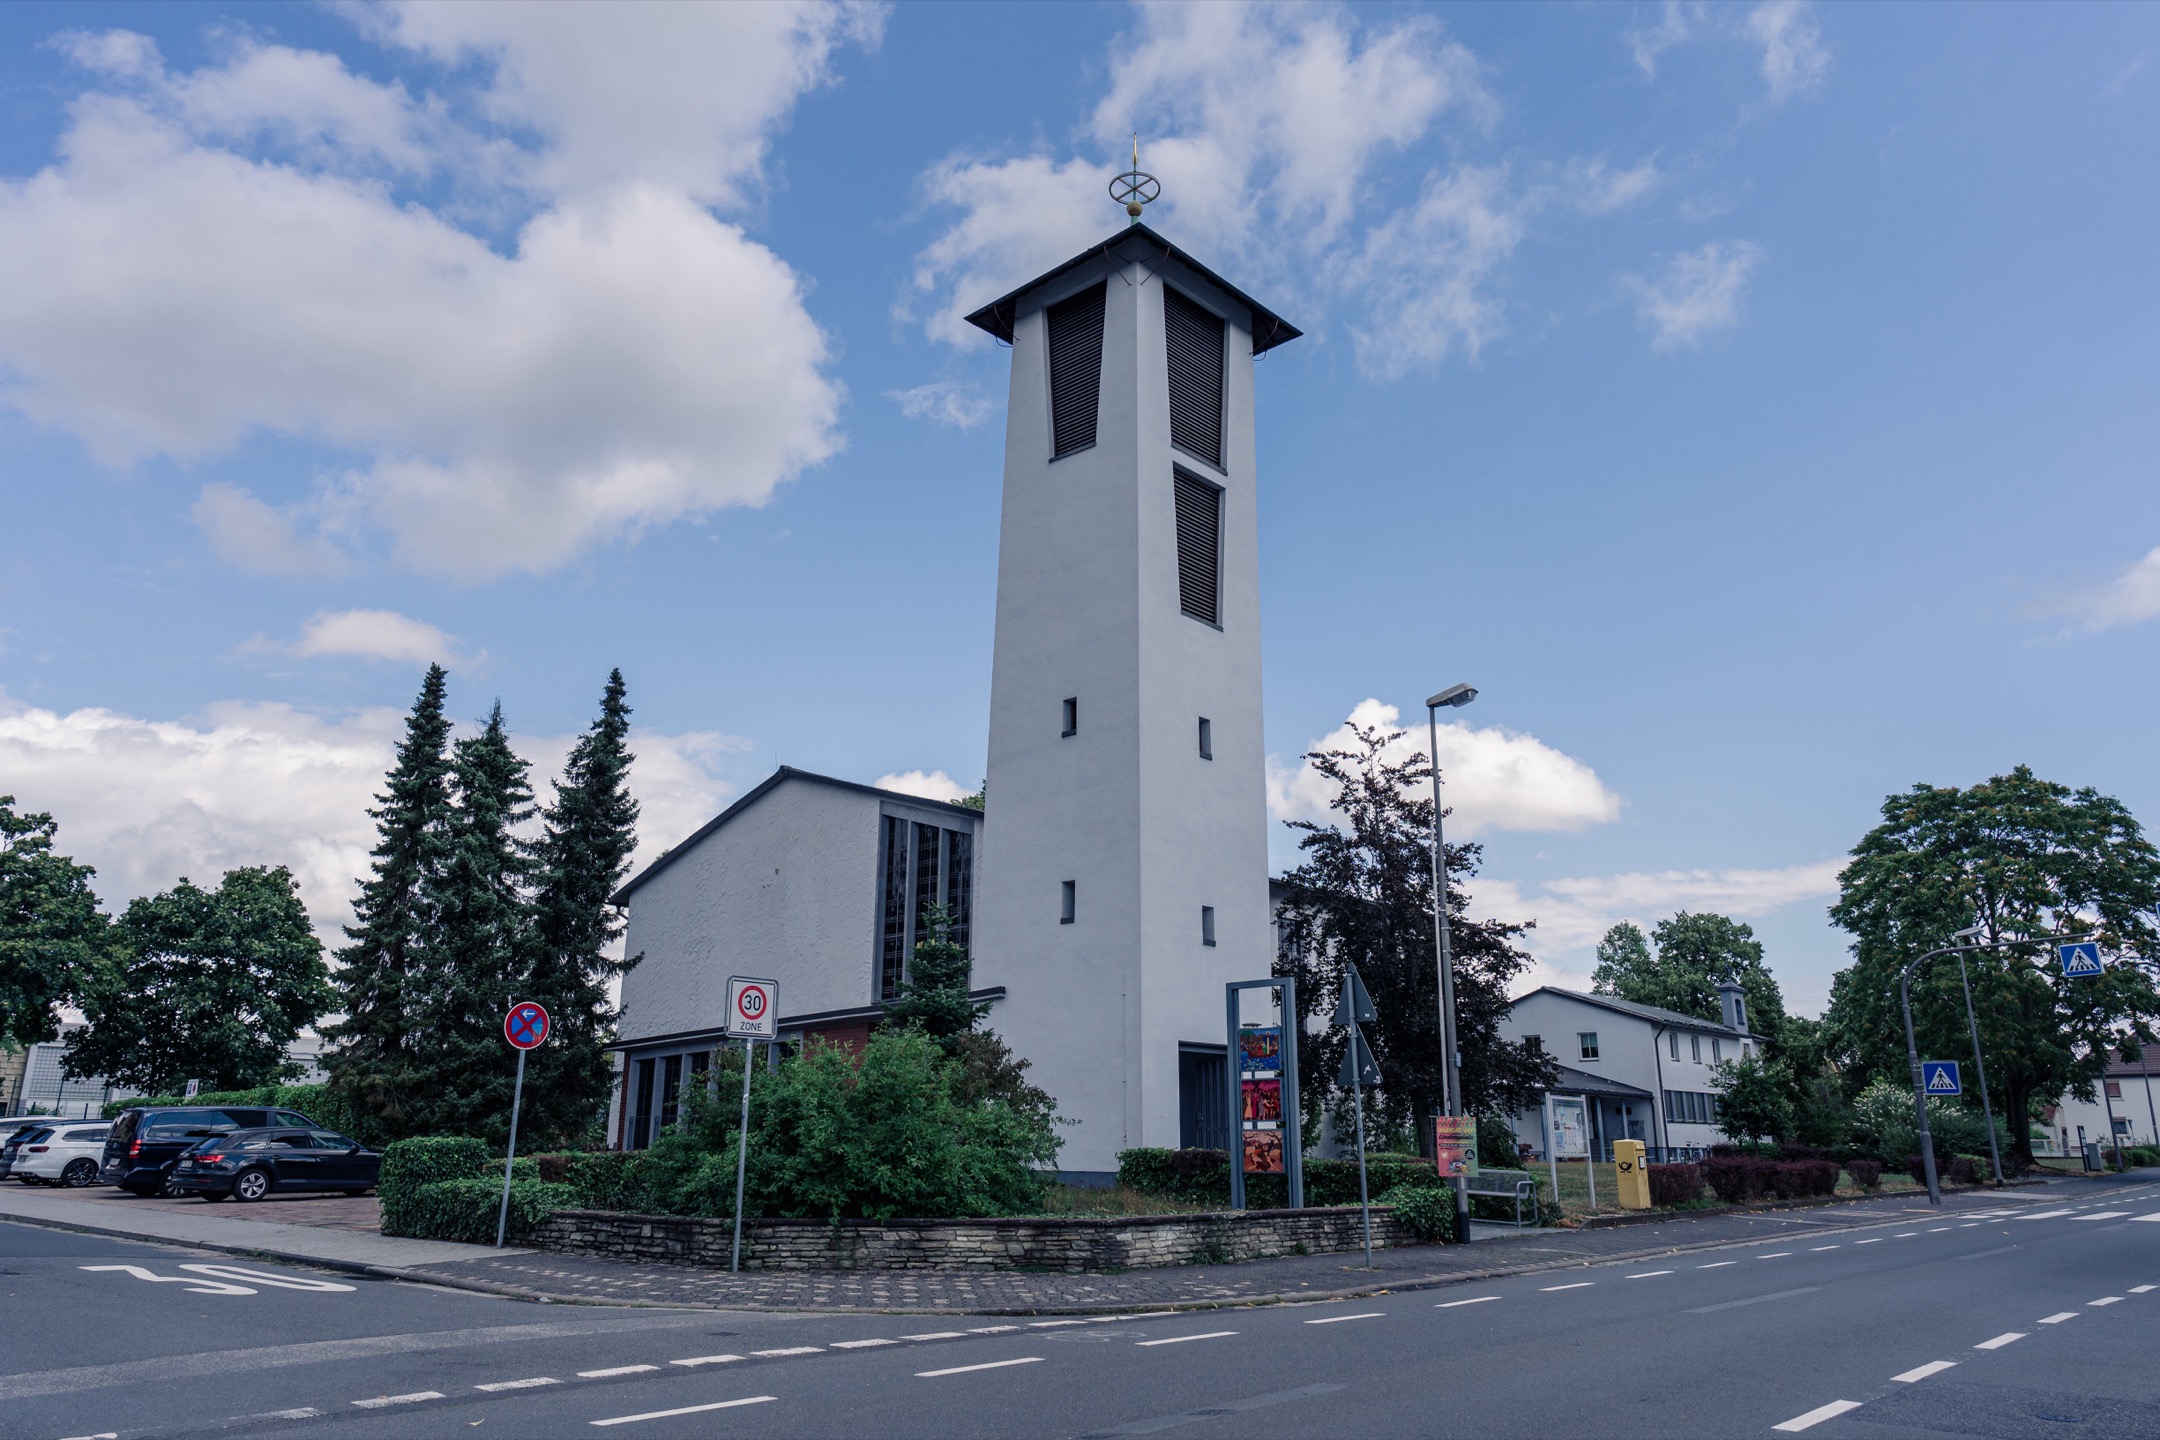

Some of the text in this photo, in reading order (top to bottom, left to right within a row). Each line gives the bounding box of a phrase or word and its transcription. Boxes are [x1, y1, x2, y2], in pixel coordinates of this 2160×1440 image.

[744, 994, 761, 1011] 30
[740, 1021, 762, 1031] ZONE
[77, 1264, 357, 1295] 30
